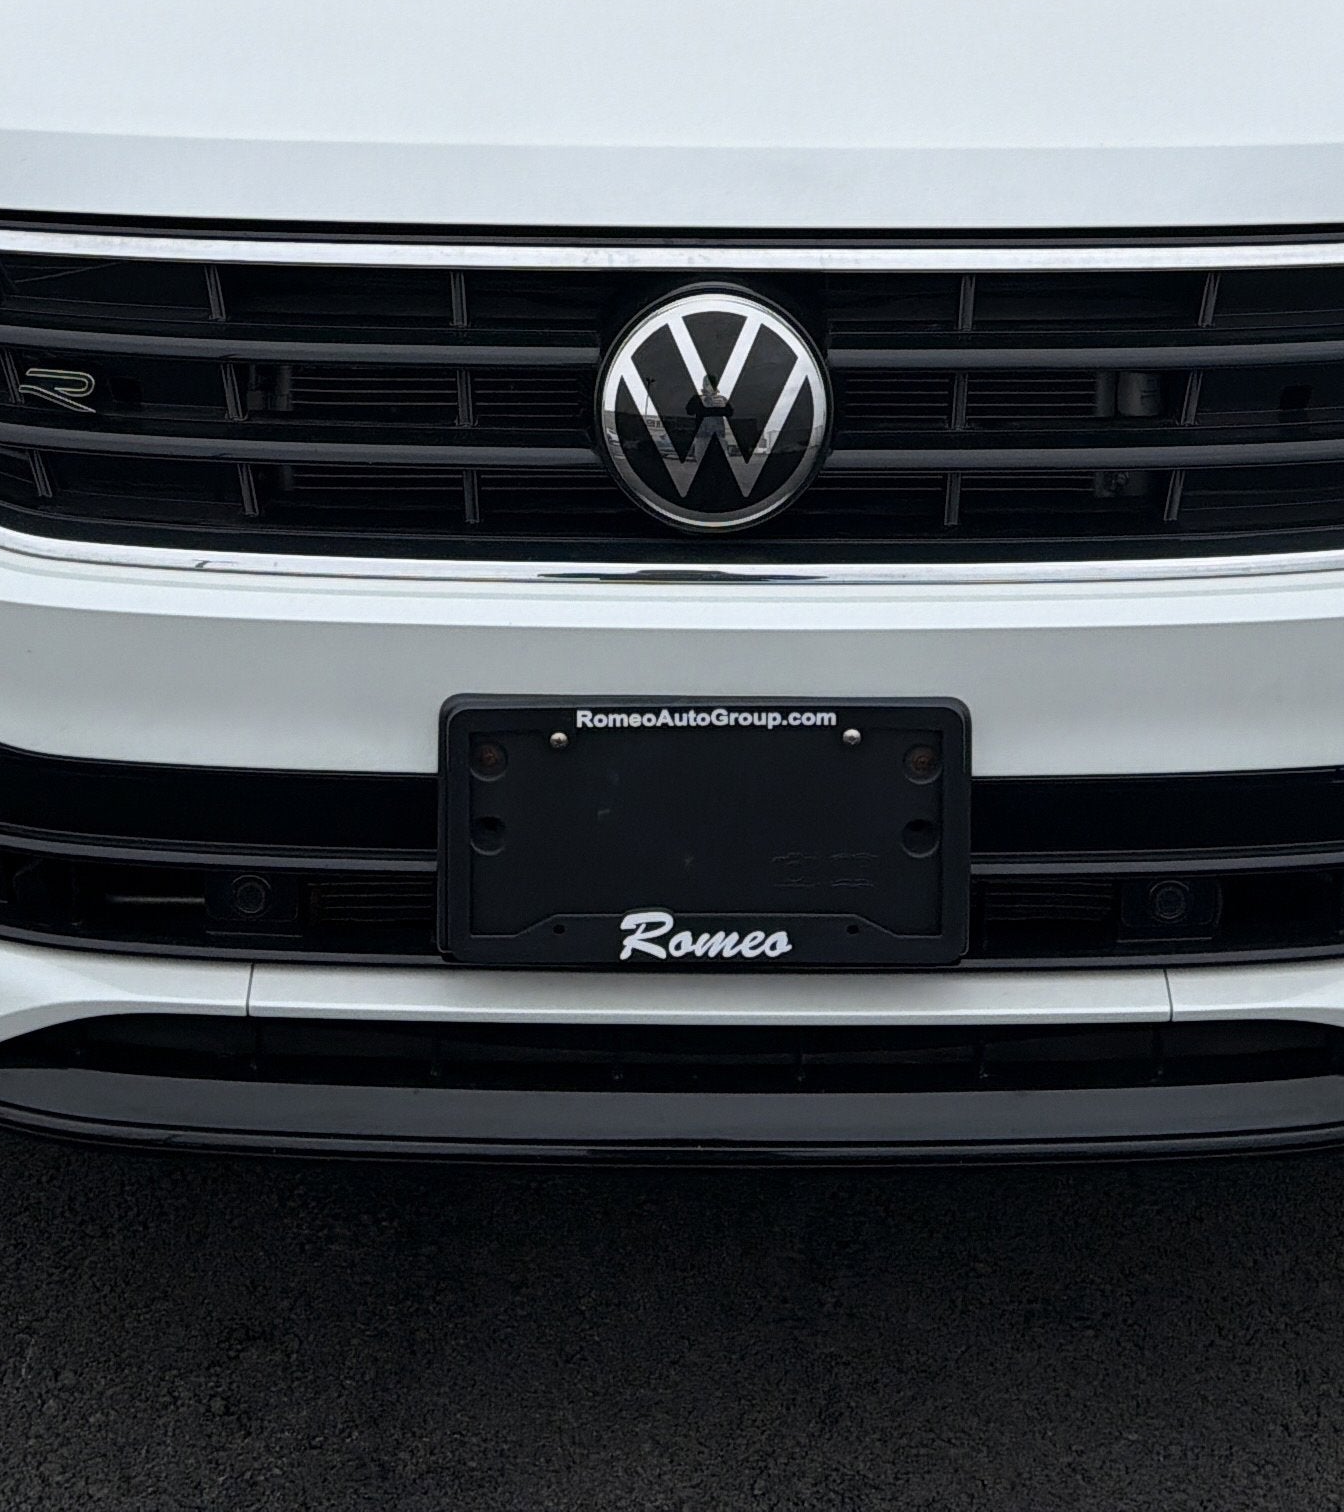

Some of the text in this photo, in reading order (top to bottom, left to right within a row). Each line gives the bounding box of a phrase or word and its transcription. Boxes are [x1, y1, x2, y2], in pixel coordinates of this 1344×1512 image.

[18, 367, 97, 413] R
[611, 308, 818, 501] VW
[576, 709, 837, 729] RomeoAutoGroup.com
[619, 911, 793, 960] Romeo
